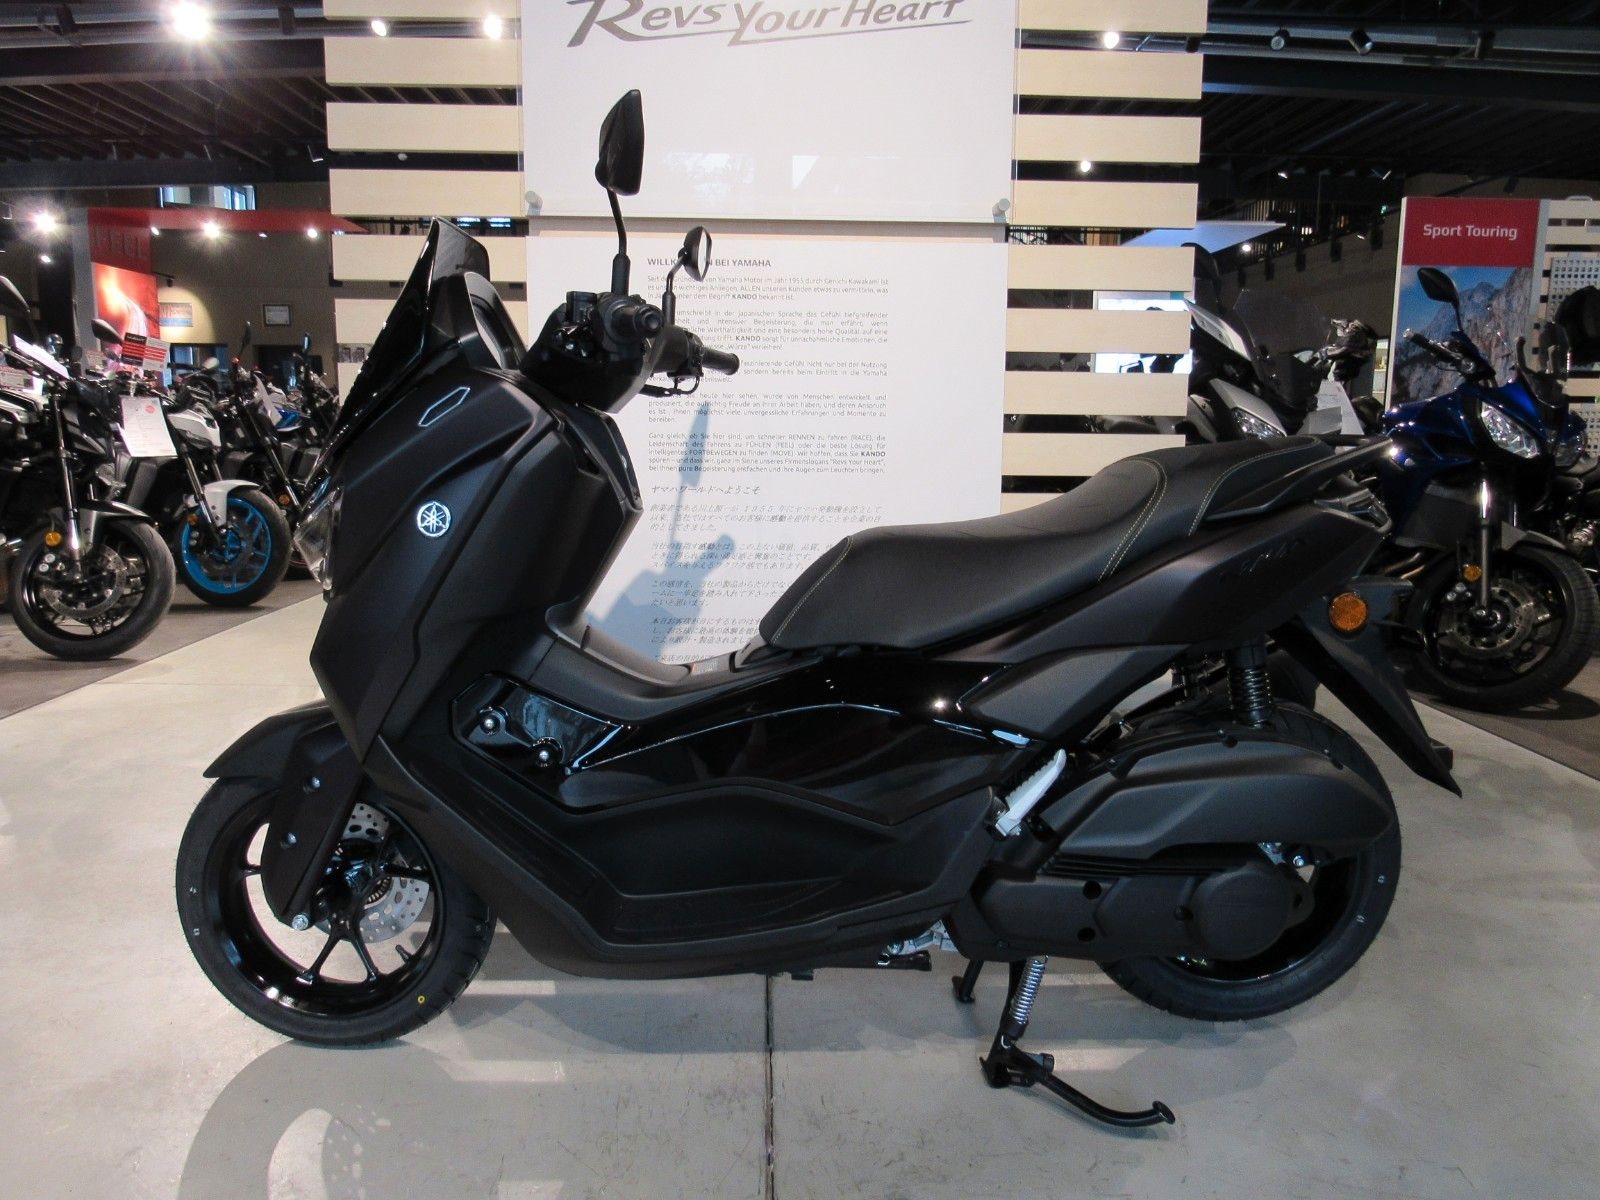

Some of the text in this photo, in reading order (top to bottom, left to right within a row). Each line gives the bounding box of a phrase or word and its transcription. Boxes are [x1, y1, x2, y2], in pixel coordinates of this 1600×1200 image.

[566, 0, 966, 47] Revs Your Heart
[1423, 223, 1518, 240] Sport Touring
[679, 284, 708, 292] wichtiges
[778, 311, 803, 319] Sprache
[844, 312, 889, 320] tiefgreifender
[696, 401, 727, 409] aufrichtig
[858, 402, 887, 410] Anspruch
[694, 410, 724, 418] möglichst
[850, 442, 873, 450] Lösung
[784, 458, 829, 466] Firmenslogans
[795, 467, 816, 475] Augen
